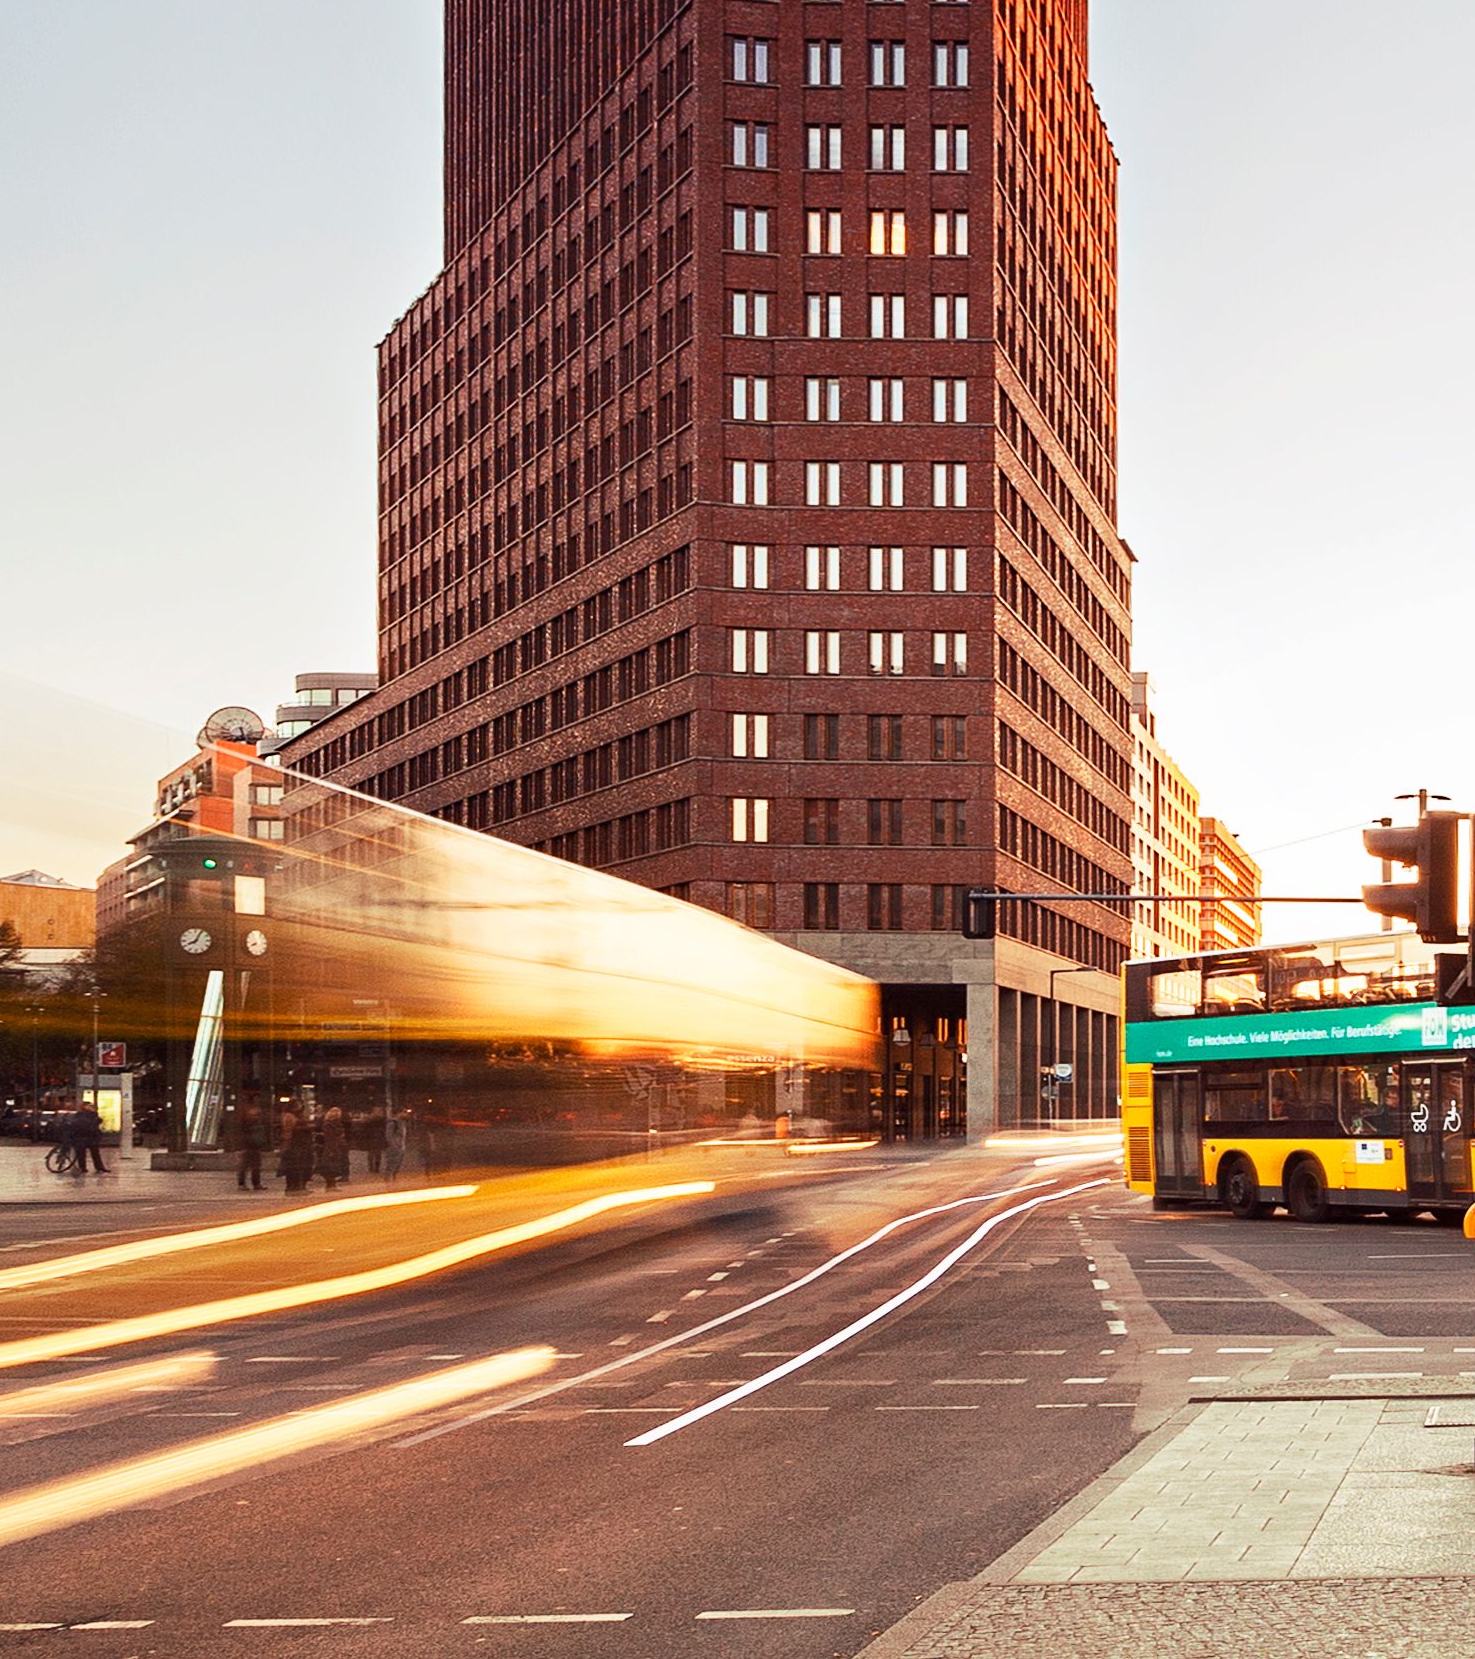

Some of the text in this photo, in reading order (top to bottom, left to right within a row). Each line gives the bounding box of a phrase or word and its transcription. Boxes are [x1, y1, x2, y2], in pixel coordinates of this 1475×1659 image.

[1187, 1035, 1203, 1047] Eine
[1204, 1033, 1249, 1046] Hochschule.
[1249, 1030, 1270, 1044] Viele
[1331, 1026, 1345, 1039] Für
